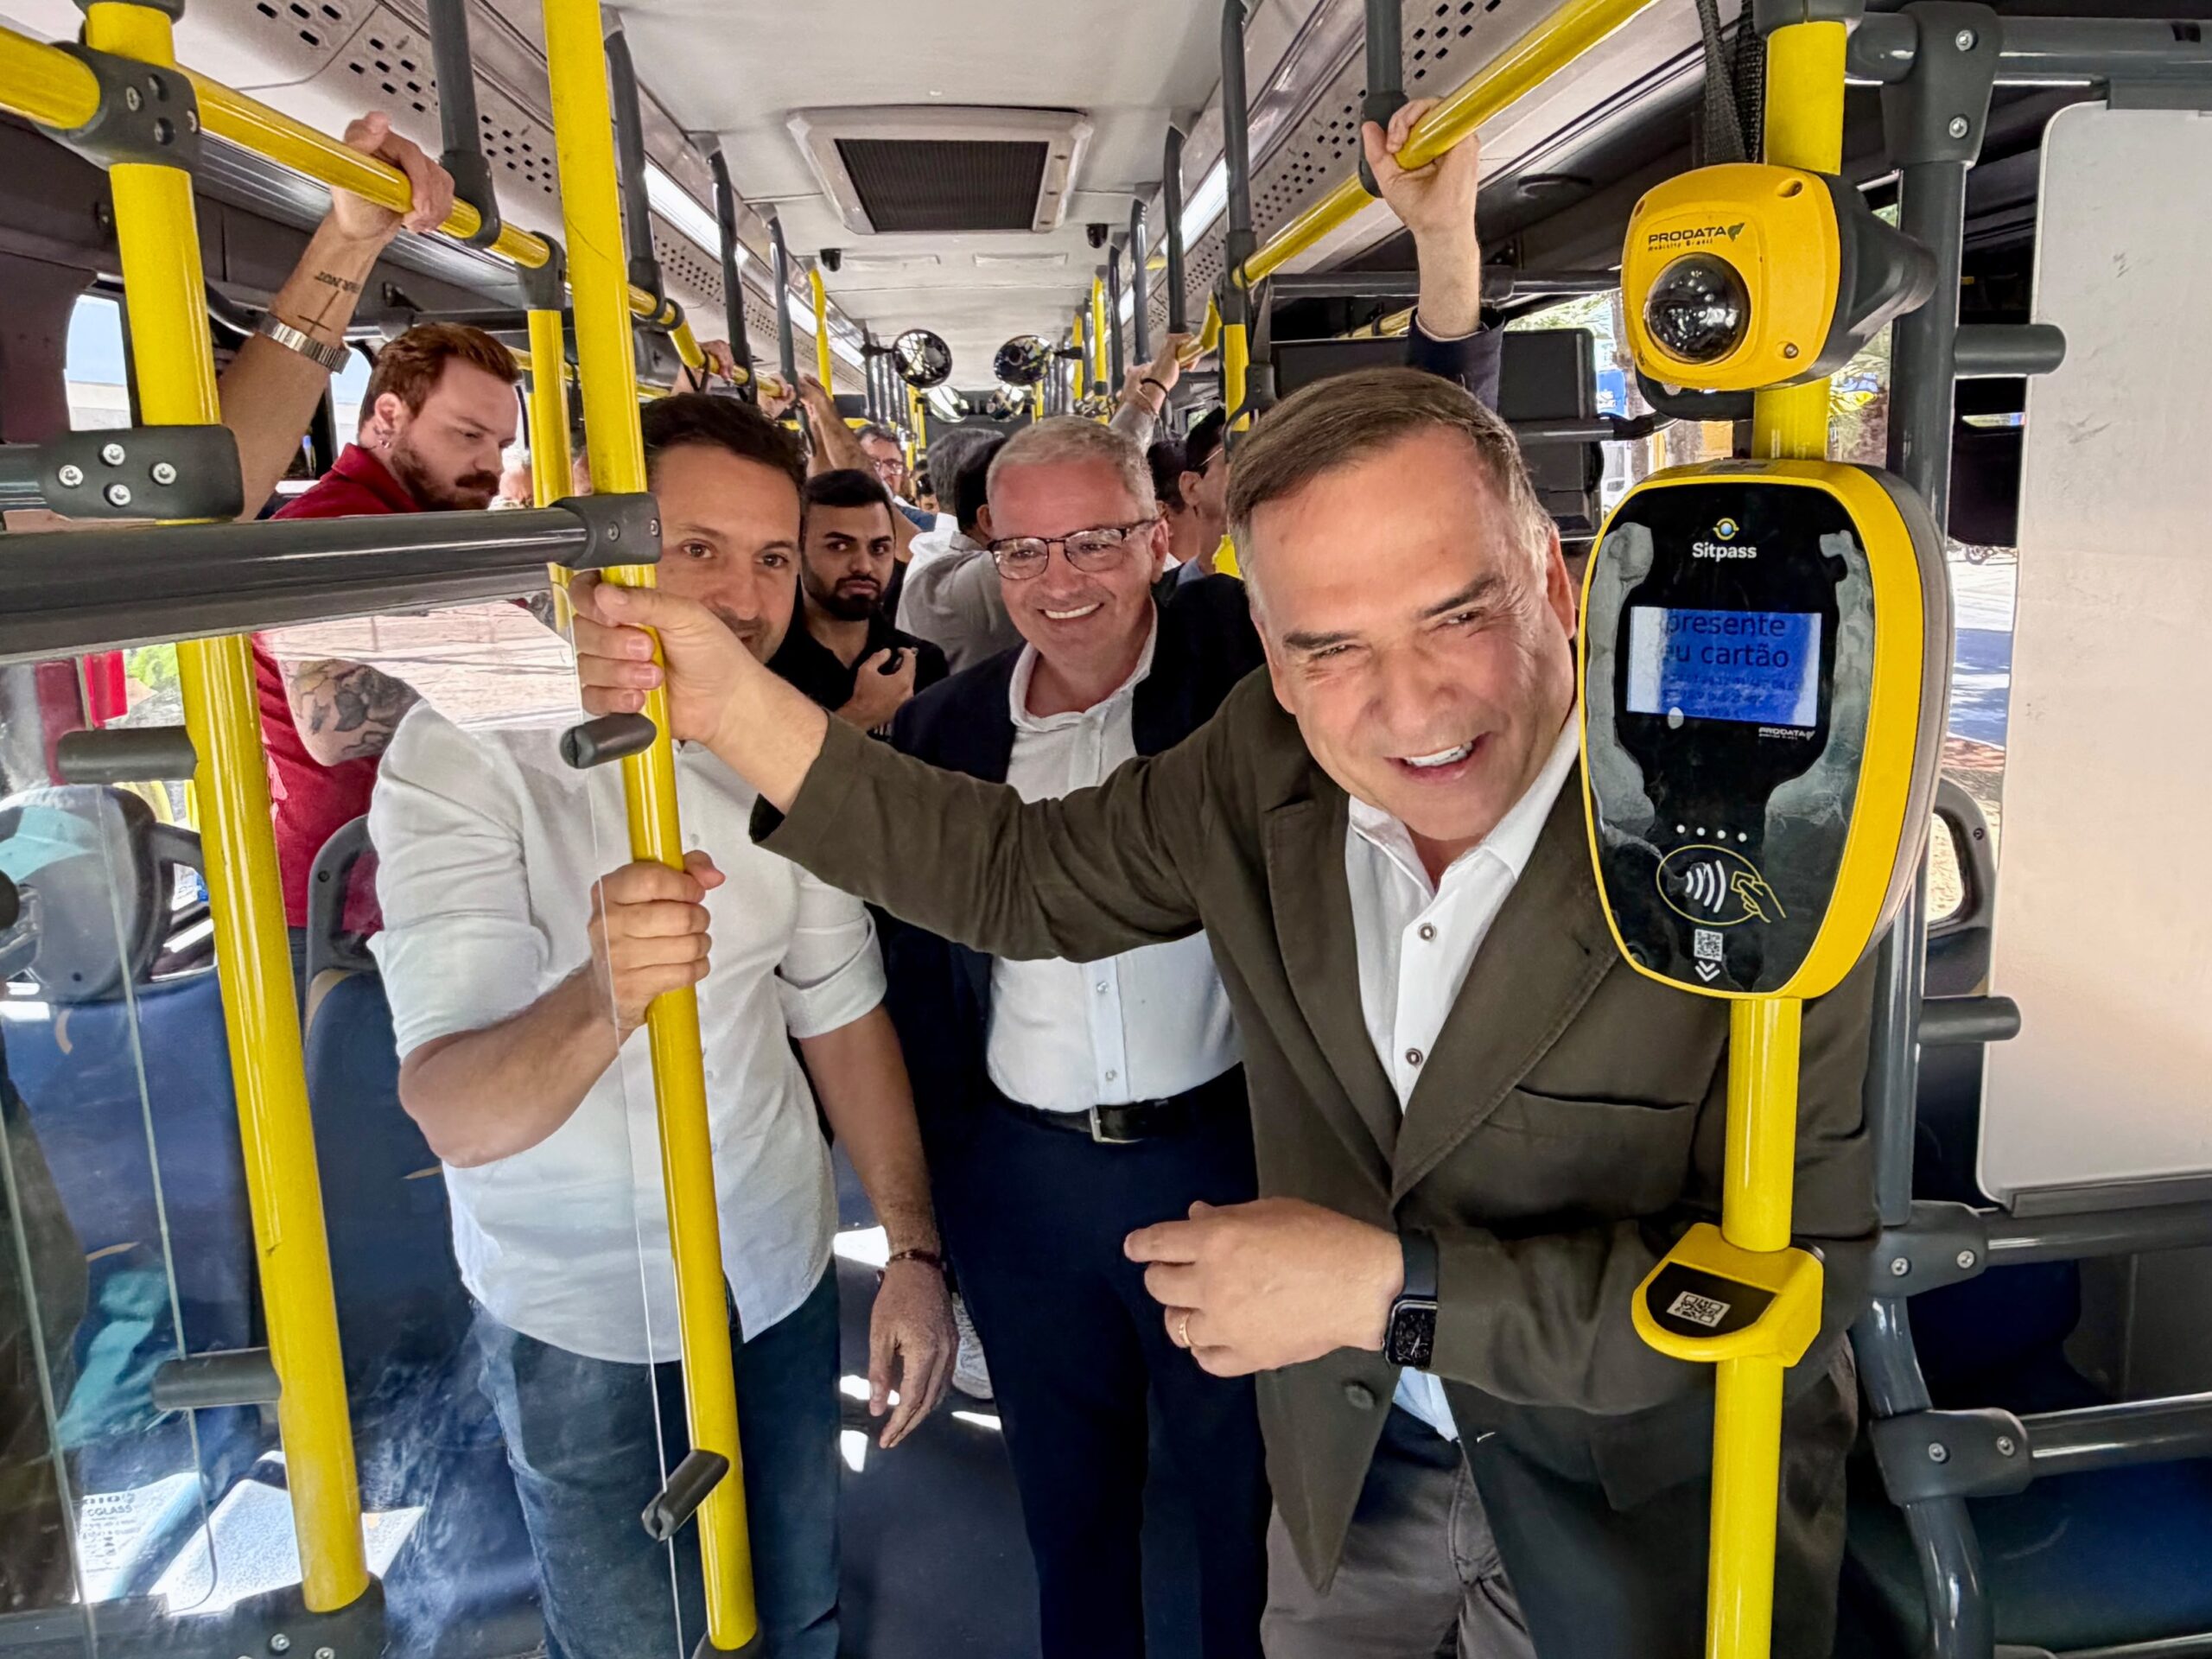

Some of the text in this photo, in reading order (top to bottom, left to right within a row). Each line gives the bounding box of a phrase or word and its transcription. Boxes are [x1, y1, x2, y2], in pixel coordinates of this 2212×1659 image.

[1648, 226, 1726, 245] PRODATA
[1692, 542, 1758, 563] Sitpass
[1700, 643, 1789, 668] cartão
[1758, 727, 1806, 737] PRODATA
